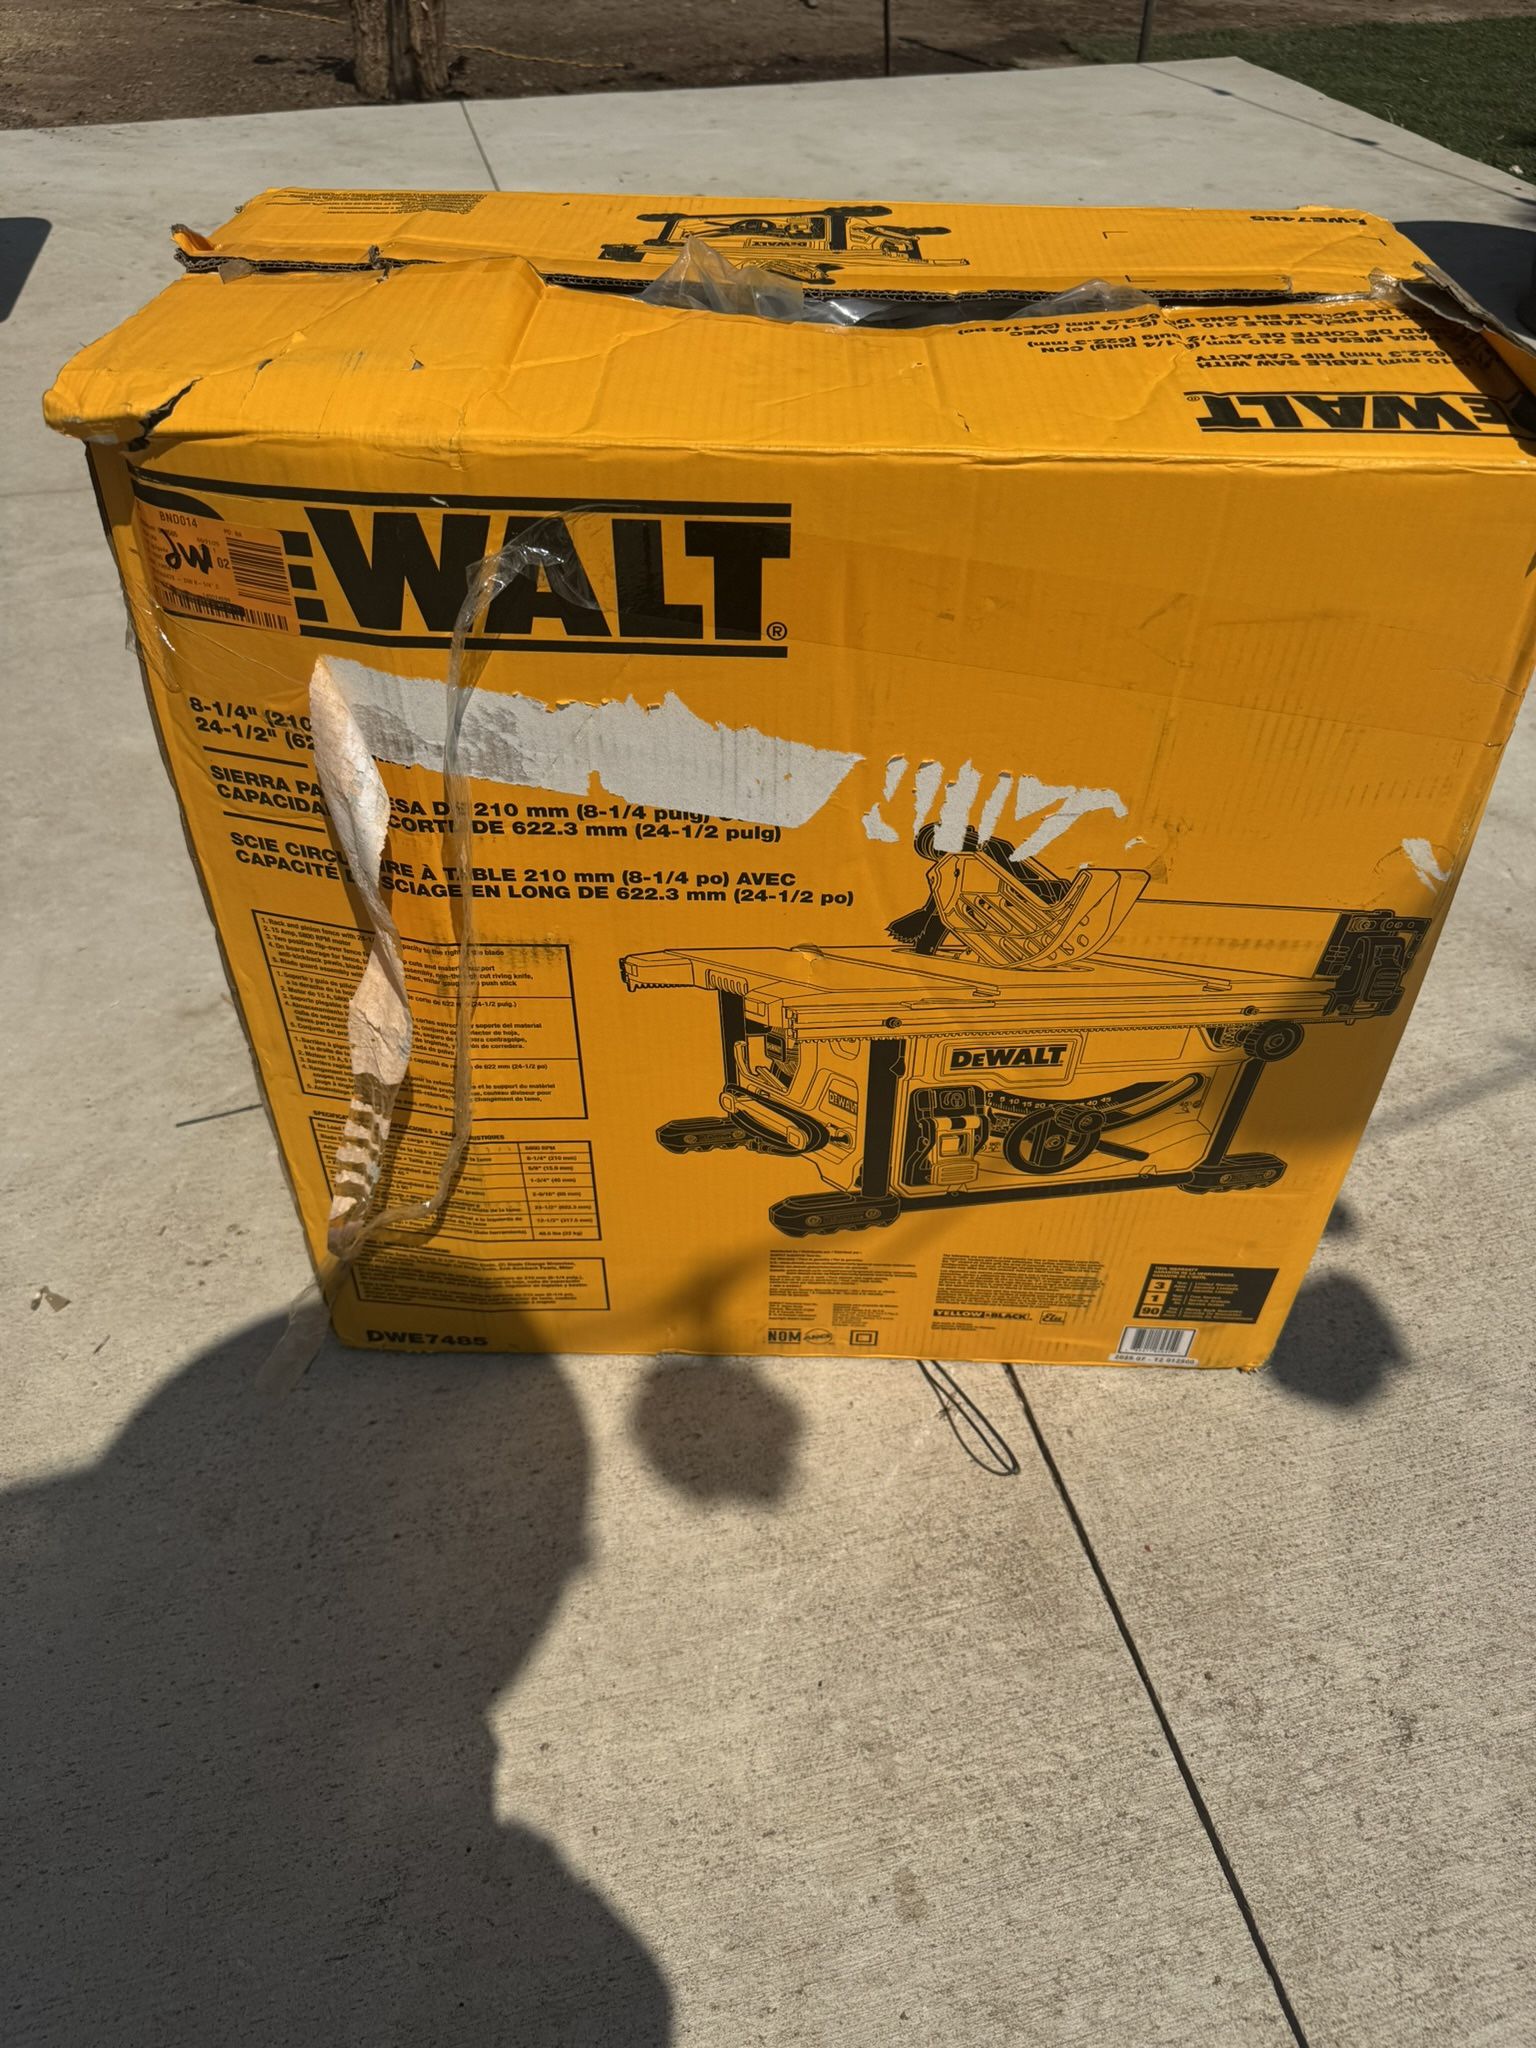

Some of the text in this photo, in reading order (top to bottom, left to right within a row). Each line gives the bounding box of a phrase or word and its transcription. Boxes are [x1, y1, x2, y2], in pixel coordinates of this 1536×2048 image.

[1196, 353, 1294, 362] CAPACITY
[1340, 351, 1382, 359] mm)
[1197, 361, 1251, 369] WITH
[1378, 358, 1420, 366] mm)
[189, 696, 257, 719] 8-1/4"
[196, 717, 315, 751] 24-1/2" (62
[210, 765, 290, 793] SIERRA
[295, 780, 323, 798] PA
[474, 803, 518, 817] 210
[526, 805, 569, 818] mm
[577, 804, 646, 822] (8-1/4
[216, 783, 332, 818] CAPACIDA
[472, 821, 505, 835] DE
[512, 821, 578, 836] 622.3
[586, 824, 627, 838] mm
[635, 823, 719, 841] (24-1/2
[726, 826, 781, 843] pulg)
[230, 832, 278, 852] SCIE
[421, 863, 438, 880] À
[442, 867, 516, 882] TBLE
[524, 869, 566, 883] 210
[574, 870, 615, 885] mm
[622, 869, 688, 886] (8-1/4
[696, 871, 730, 888] po)
[736, 872, 796, 887] AVEC
[236, 849, 854, 908] CAPACITÉ SCIAGE EN LONG DE 622.3 mm (24-1/2 po)
[950, 1046, 1067, 1069] DEWALT
[1153, 1281, 1166, 1290] 3
[1150, 1294, 1160, 1302] 1
[936, 1310, 1029, 1321] YELLOW BLACK
[1141, 1306, 1160, 1315] 90
[366, 1329, 489, 1347] DWE7485
[768, 1330, 801, 1342] NOM
